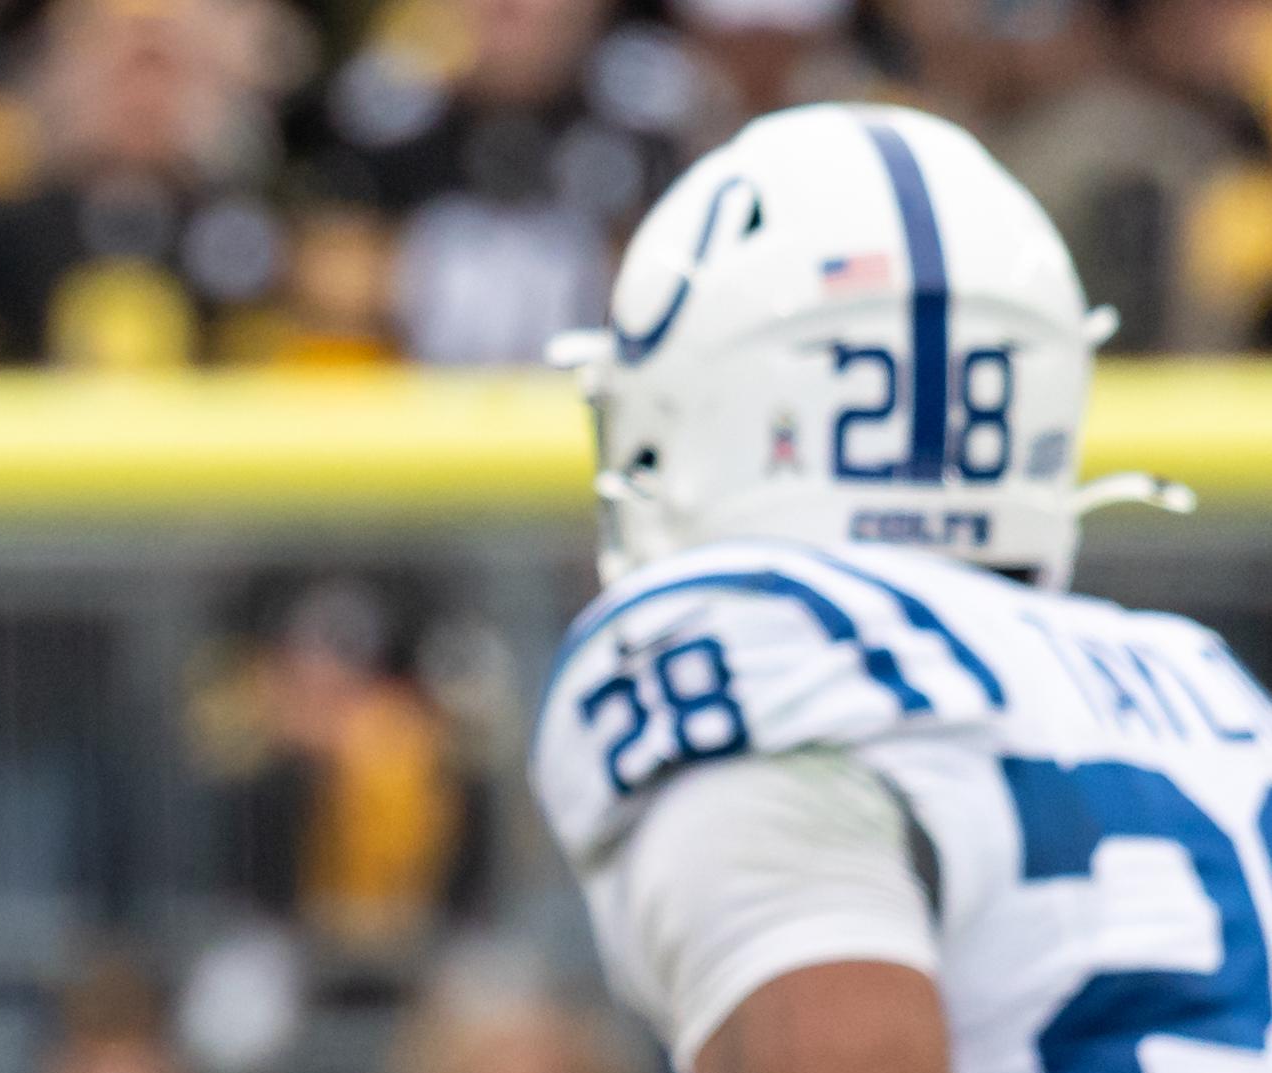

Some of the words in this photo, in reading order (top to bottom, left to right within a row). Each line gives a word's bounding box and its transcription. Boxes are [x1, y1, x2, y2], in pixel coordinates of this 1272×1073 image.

[833, 347, 1014, 480] 28
[581, 636, 748, 794] 28
[1019, 612, 1258, 743] TAYL
